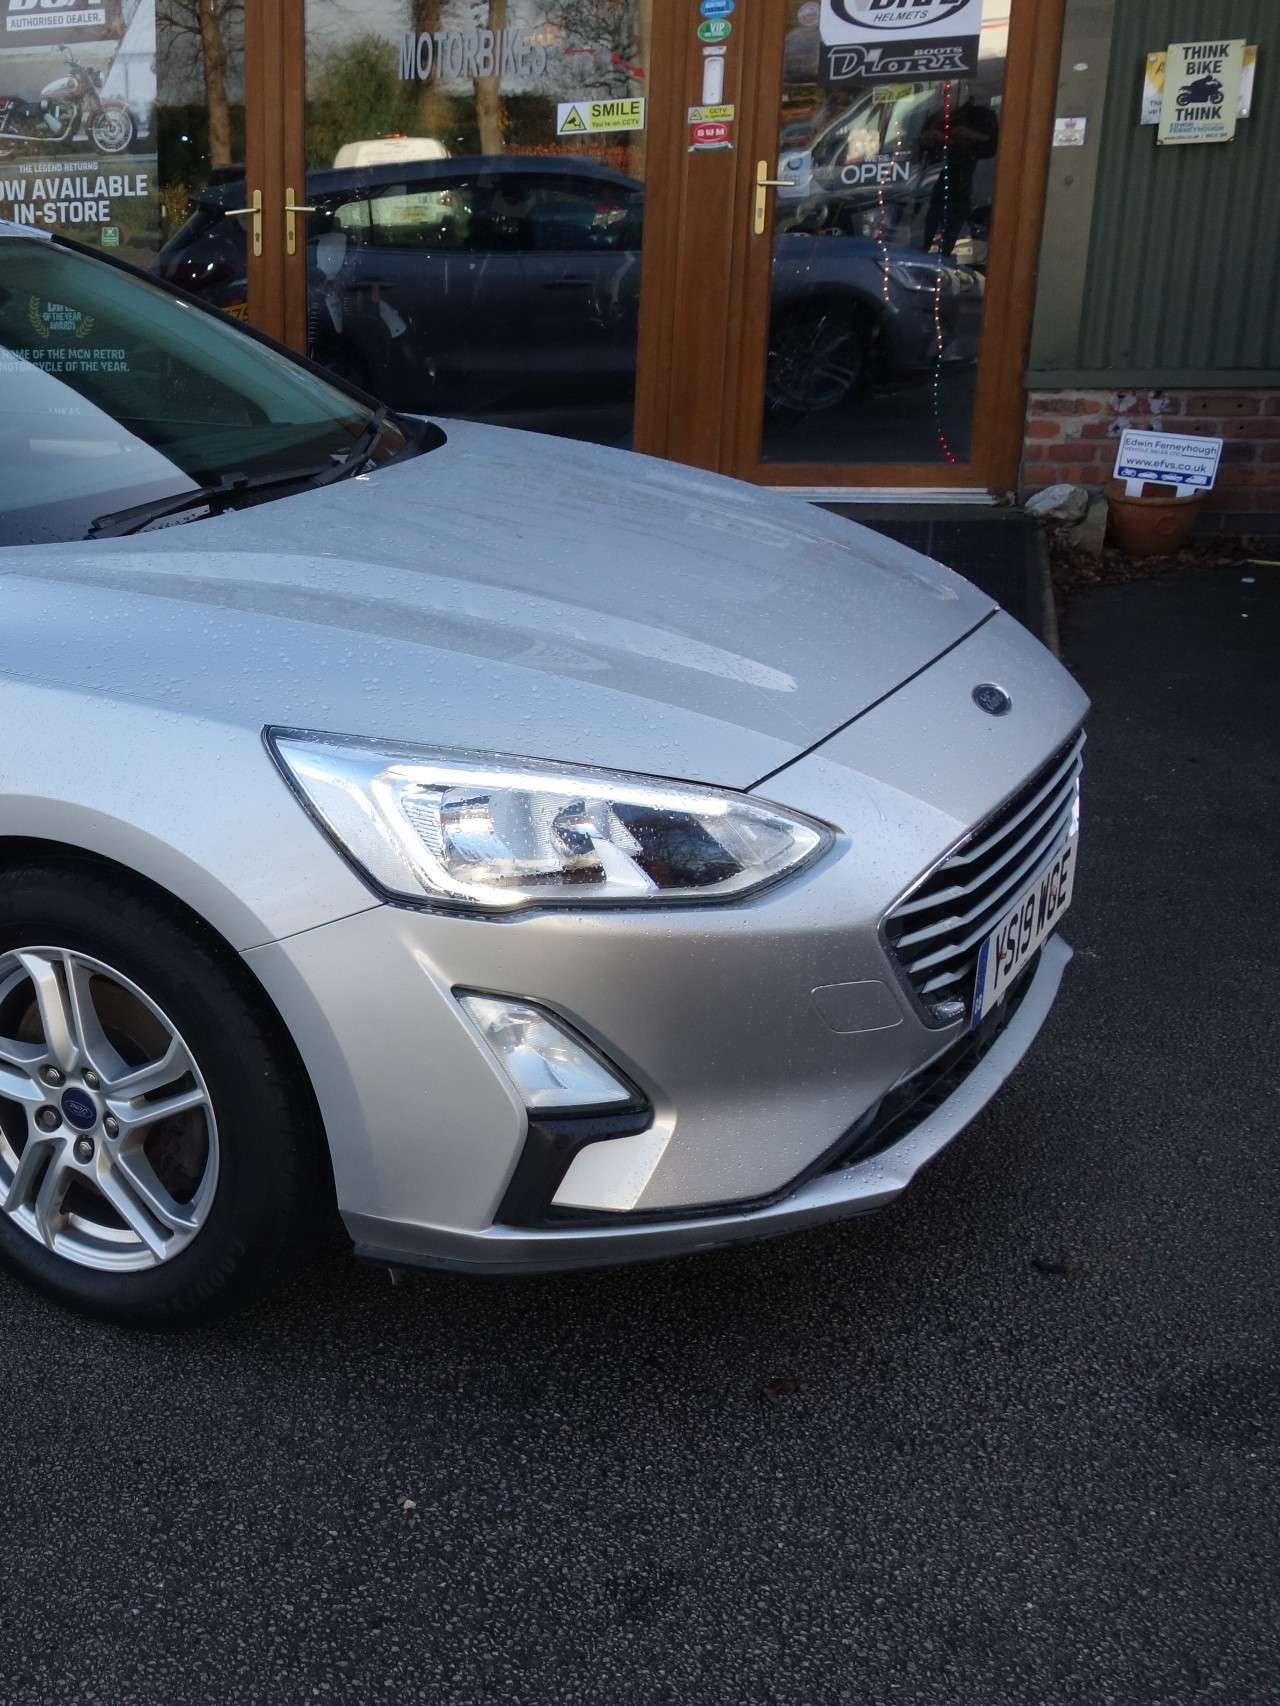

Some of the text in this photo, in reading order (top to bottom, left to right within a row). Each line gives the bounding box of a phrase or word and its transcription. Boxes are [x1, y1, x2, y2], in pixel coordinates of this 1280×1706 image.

[10, 15, 64, 27] AUTHORISED
[873, 10, 928, 22] HELMETS
[399, 29, 548, 80] MOTORBIKES
[913, 46, 963, 56] BOOTS
[1182, 44, 1230, 60] THINK
[1186, 60, 1222, 75] BIKE
[591, 101, 640, 117] SMILE
[1175, 106, 1223, 121] THINK
[19, 161, 98, 173] THE LEGEND RETURNS
[840, 161, 910, 184] OPEN
[32, 174, 148, 200] AVAILABLE
[14, 200, 111, 224] IN-STORE
[33, 349, 45, 359] OF
[46, 349, 65, 359] THE
[68, 349, 91, 359] MCN
[93, 349, 125, 359] RETRO
[66, 361, 79, 372] OF
[79, 361, 101, 372] THE
[1125, 438, 1153, 448] Edwin
[1154, 440, 1217, 456] Ferneyhough
[1126, 457, 1208, 474] www.efvs.co.uk
